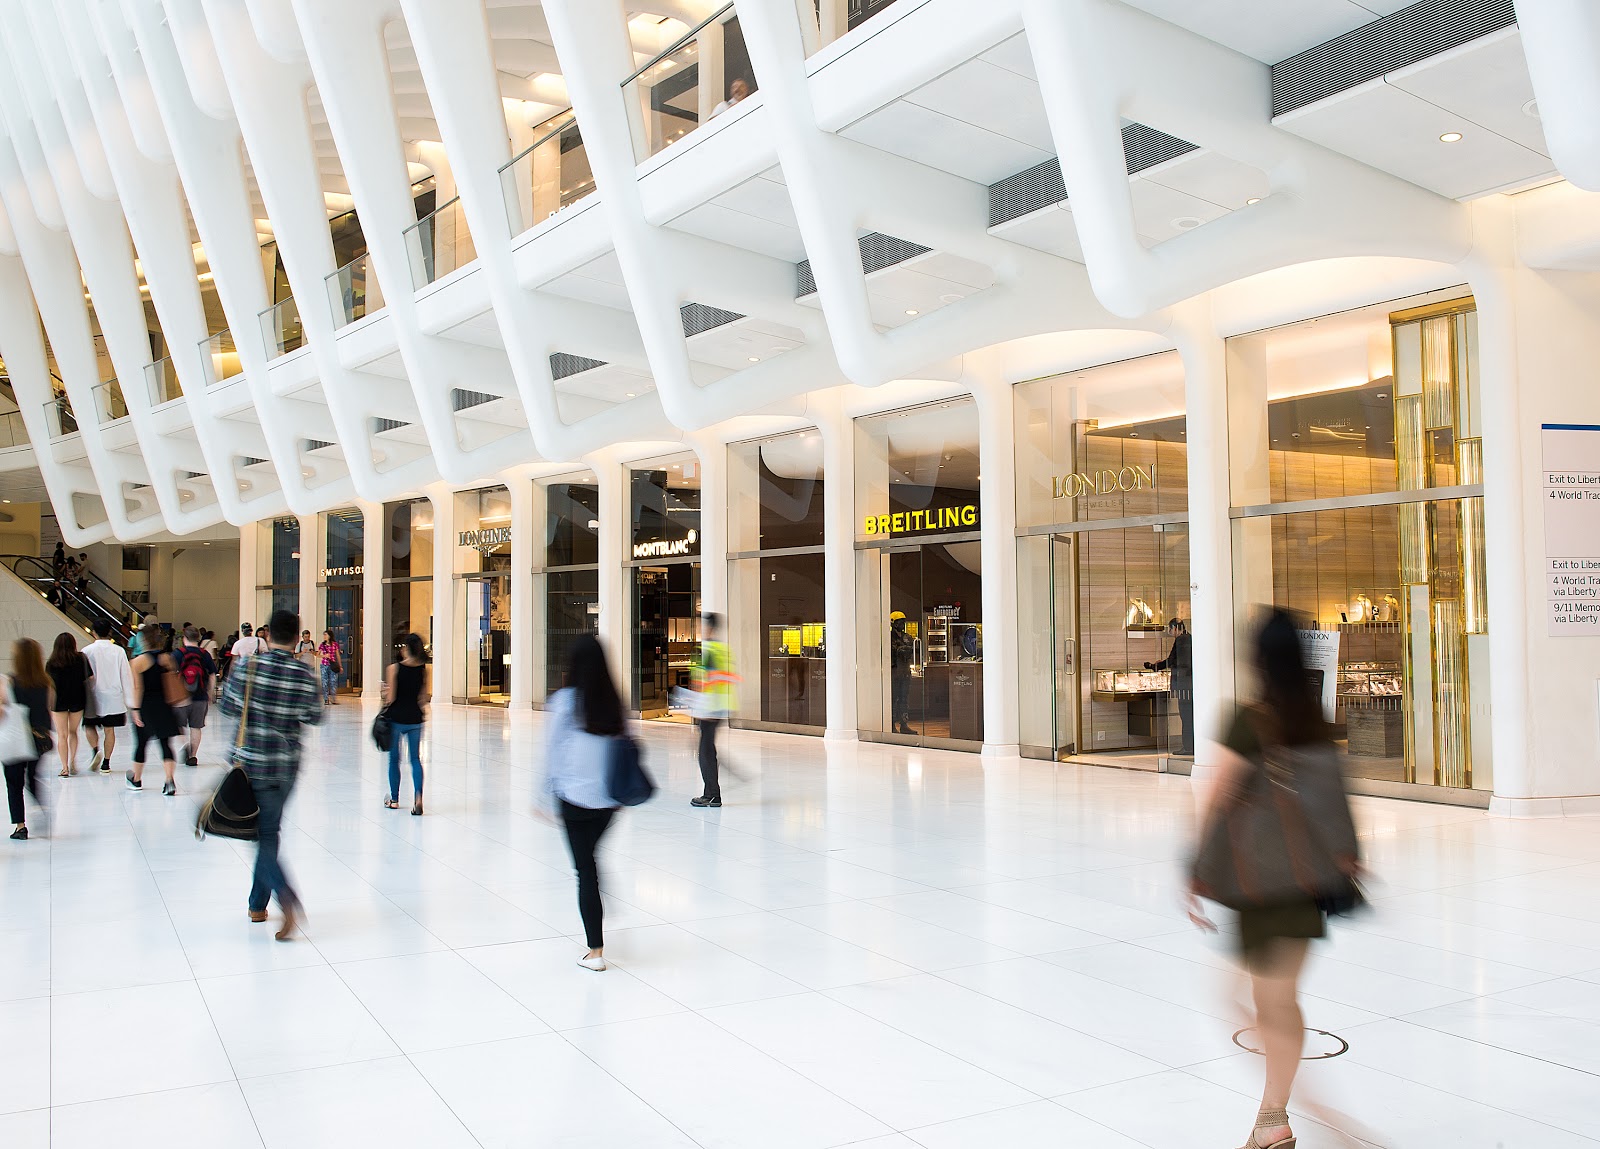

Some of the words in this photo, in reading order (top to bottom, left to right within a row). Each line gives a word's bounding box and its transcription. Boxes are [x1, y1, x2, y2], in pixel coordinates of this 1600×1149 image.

[1052, 463, 1156, 499] LONDON
[1549, 474, 1565, 484] Exit
[1567, 475, 1576, 484] to
[1549, 490, 1556, 500] 4
[1557, 490, 1582, 500] World
[865, 505, 976, 535] BREITLING
[633, 538, 689, 558] MONTBLANC
[1552, 560, 1568, 569] Exit
[1570, 560, 1579, 569] to
[1552, 576, 1559, 585] 4
[1561, 576, 1586, 585] World
[1553, 588, 1566, 596] via
[1567, 587, 1597, 598] Liberty
[1553, 603, 1573, 612] 9/11
[1554, 614, 1567, 623] via
[1568, 613, 1598, 625] Liberty
[1300, 632, 1330, 641] LONDON
